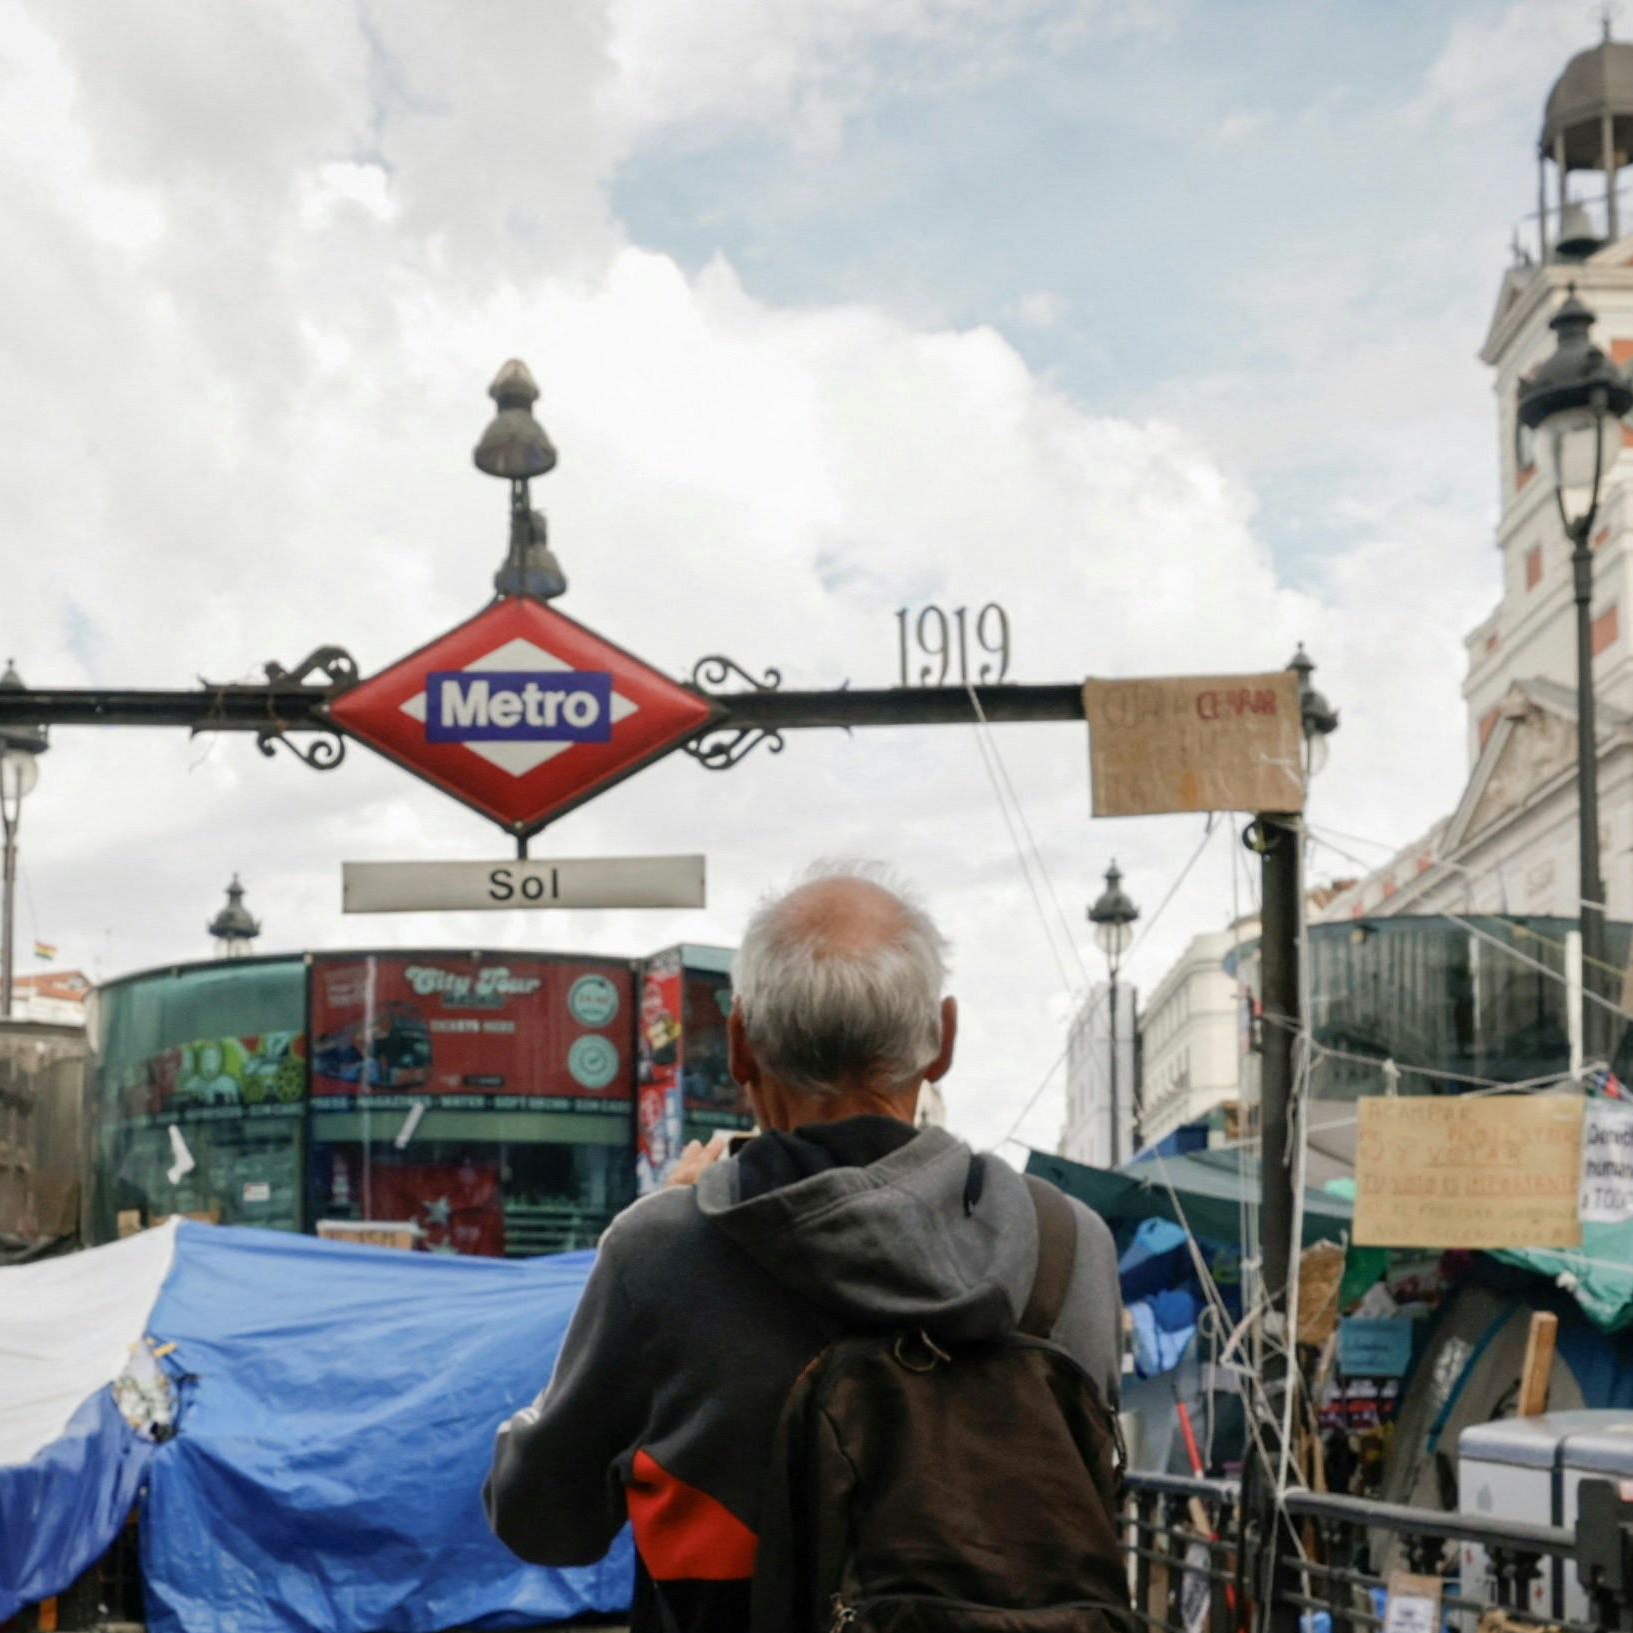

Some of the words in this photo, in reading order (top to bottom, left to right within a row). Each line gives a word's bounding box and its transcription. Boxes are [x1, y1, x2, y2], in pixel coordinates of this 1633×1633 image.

[895, 602, 1011, 686] 1919
[441, 680, 599, 730] Metro
[488, 868, 561, 901] Sol
[404, 965, 471, 996] City
[475, 966, 543, 996] Tour
